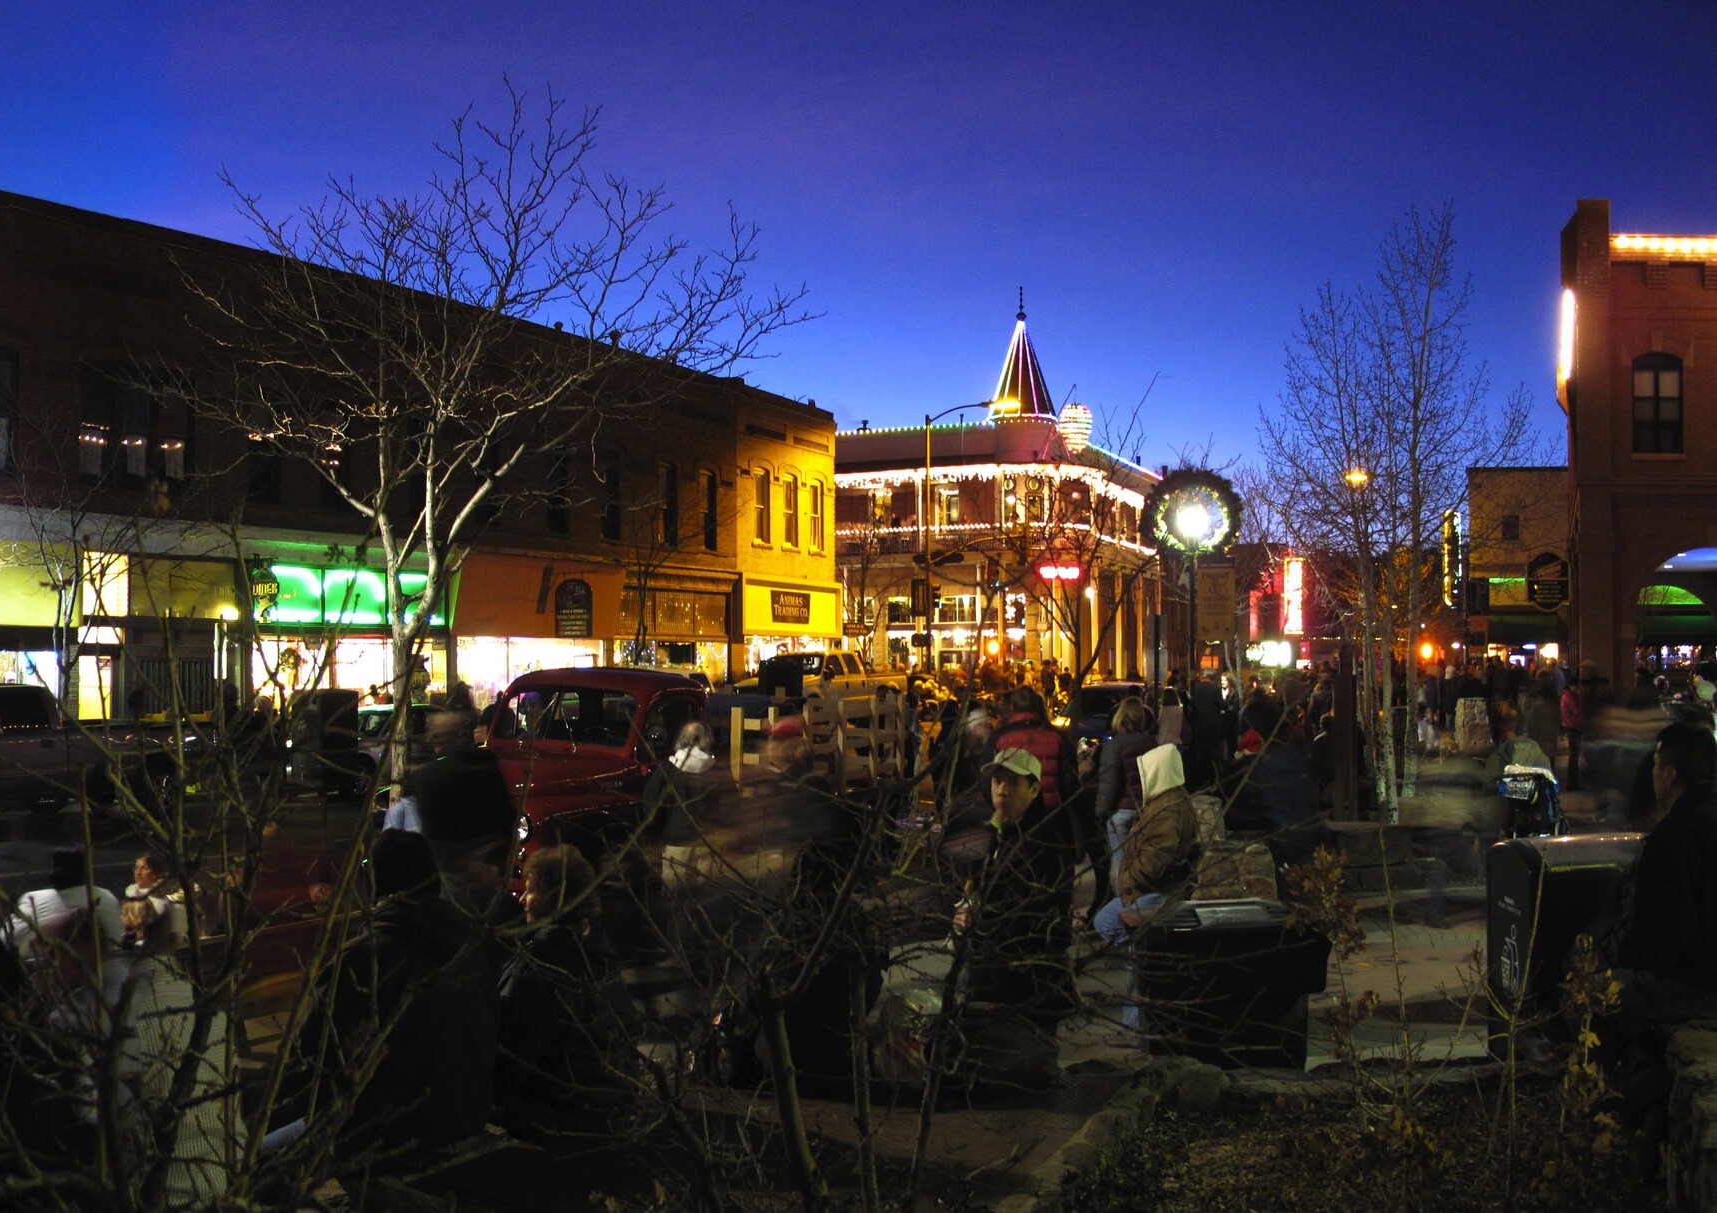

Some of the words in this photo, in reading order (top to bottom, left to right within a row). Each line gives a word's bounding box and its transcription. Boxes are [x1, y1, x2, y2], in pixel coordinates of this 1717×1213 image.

[252, 582, 278, 596] DINER
[779, 594, 804, 607] ANIMAS
[773, 604, 799, 618] TRADING
